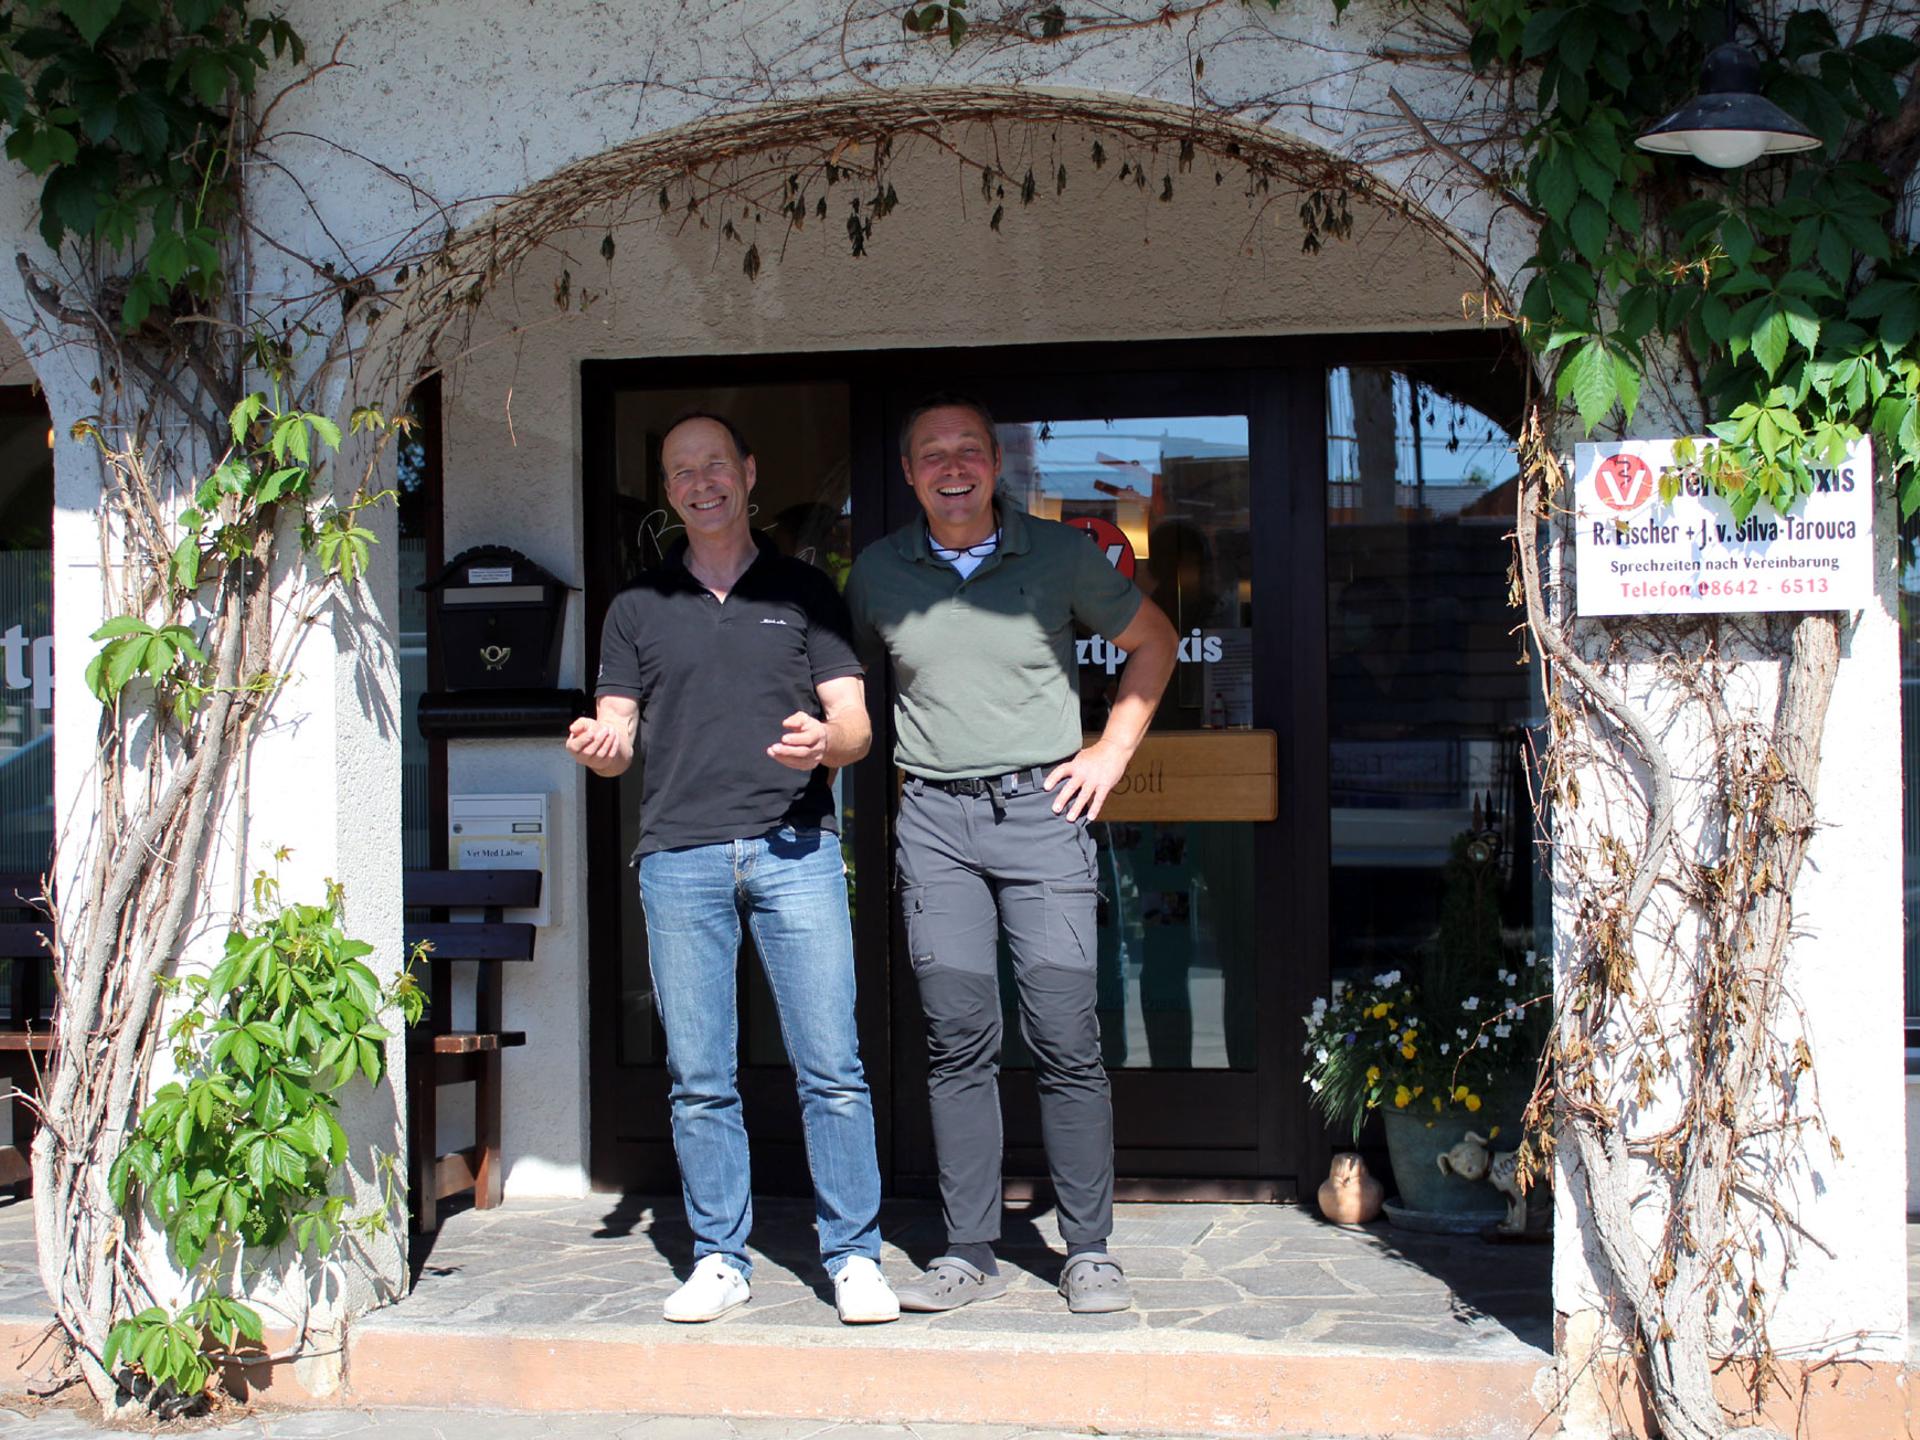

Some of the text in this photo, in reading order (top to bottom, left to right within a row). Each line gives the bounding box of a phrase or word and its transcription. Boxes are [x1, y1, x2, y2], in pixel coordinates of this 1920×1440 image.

[1593, 521, 1611, 546] R.
[1615, 518, 1680, 546] Fischer
[1698, 518, 1713, 551] J.
[1716, 523, 1732, 543] v.
[1735, 515, 1857, 543] Silva-Tarouca
[1610, 555, 1840, 576] Sprechzeiten nach Vereinbarung
[1620, 580, 1691, 598] Telefon
[1697, 579, 1759, 596] 08642
[1780, 577, 1829, 594] 6513
[482, 848, 499, 857] Med
